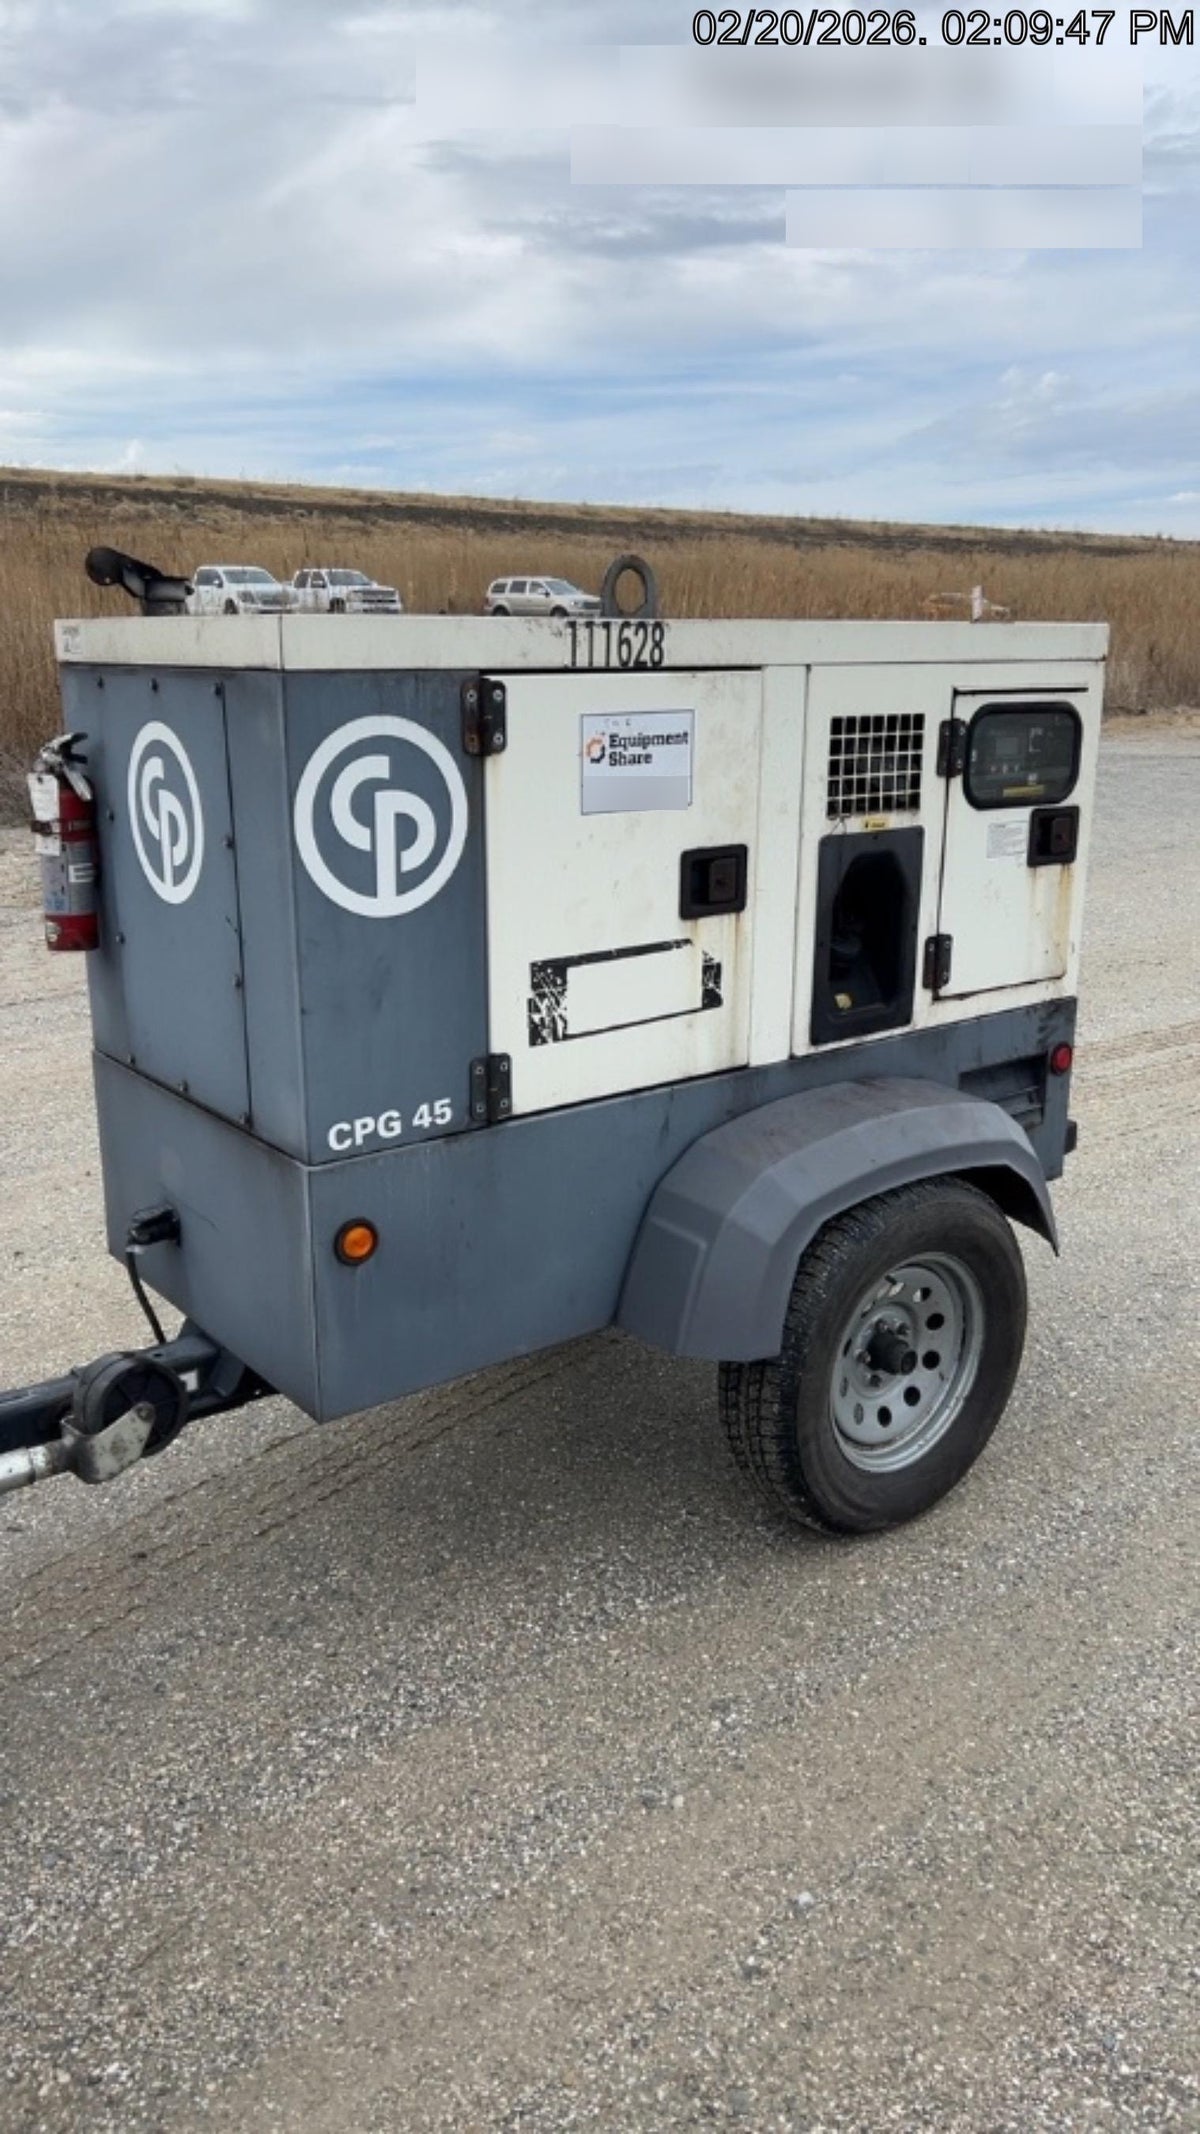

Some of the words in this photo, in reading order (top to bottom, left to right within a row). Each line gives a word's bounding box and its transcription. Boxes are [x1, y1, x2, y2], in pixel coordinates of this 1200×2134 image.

[567, 621, 665, 668] 111628
[609, 731, 689, 750] Equipment
[609, 751, 653, 767] Share
[328, 1109, 402, 1151] CPG
[412, 1097, 453, 1129] 45
